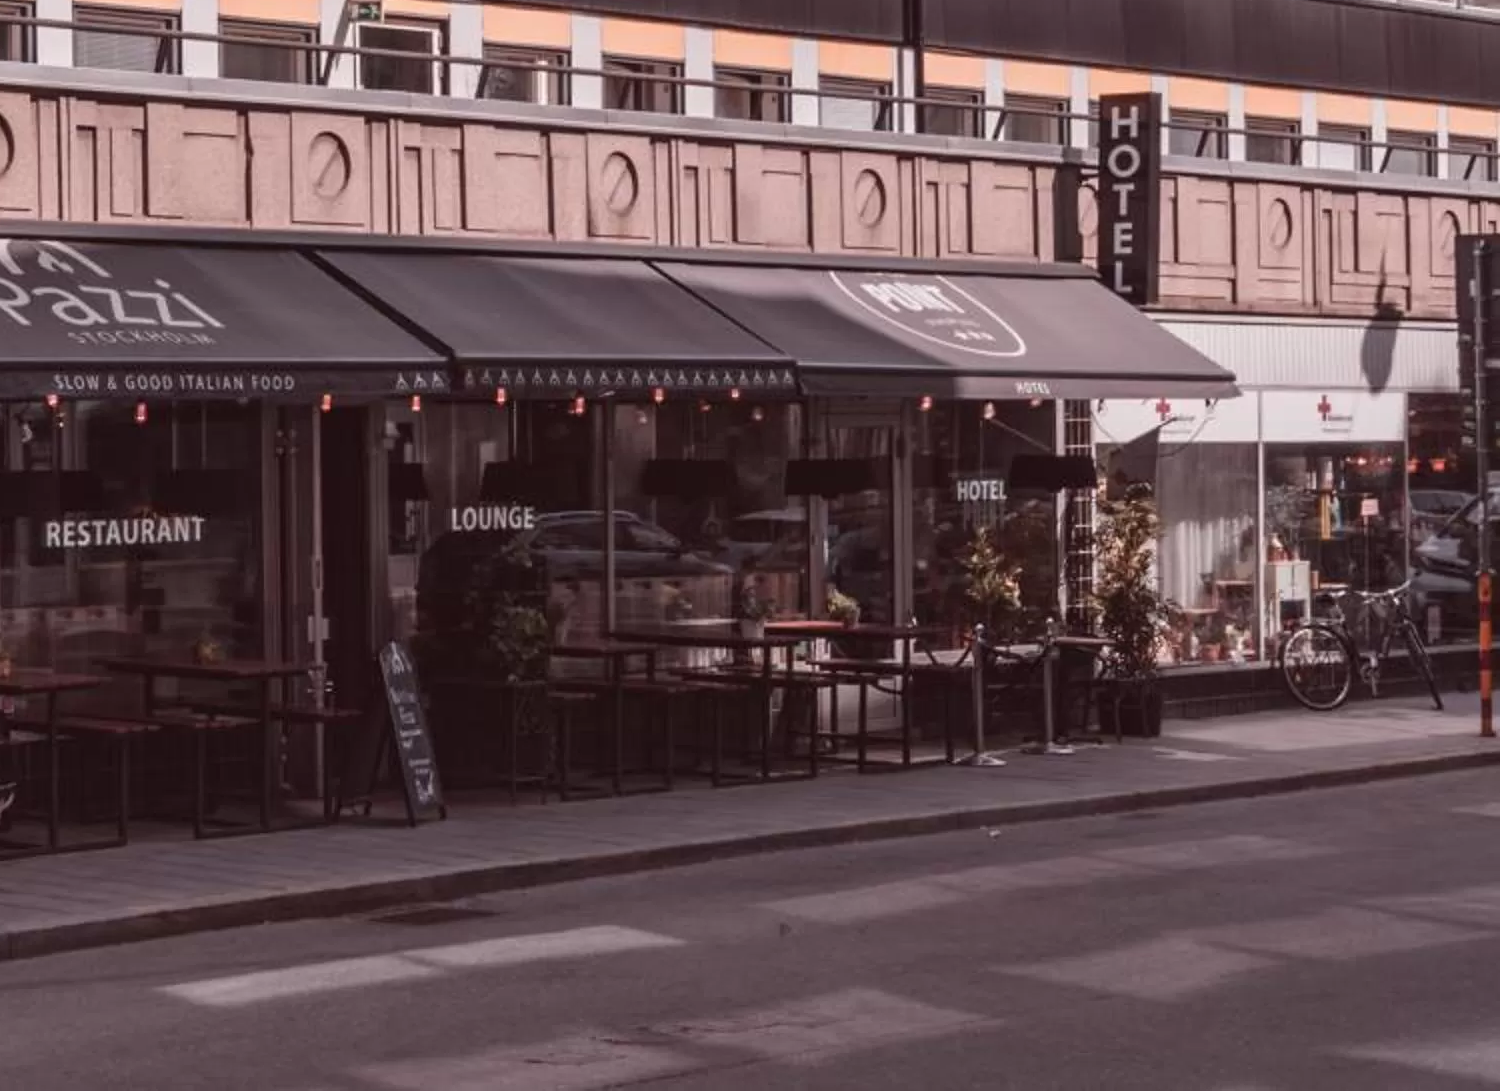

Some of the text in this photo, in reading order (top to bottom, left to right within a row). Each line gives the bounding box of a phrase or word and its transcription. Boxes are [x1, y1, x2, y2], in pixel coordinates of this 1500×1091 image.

[1109, 106, 1141, 294] HOTEL
[67, 330, 217, 346] STOCKHOLM
[52, 373, 296, 391] SLOW & GOOD ITALIAN FOOD
[1014, 381, 1051, 395] HOTEL
[956, 479, 1008, 501] HOTEL
[450, 506, 536, 532] LOUNGE
[45, 516, 206, 547] RESTAURANT
